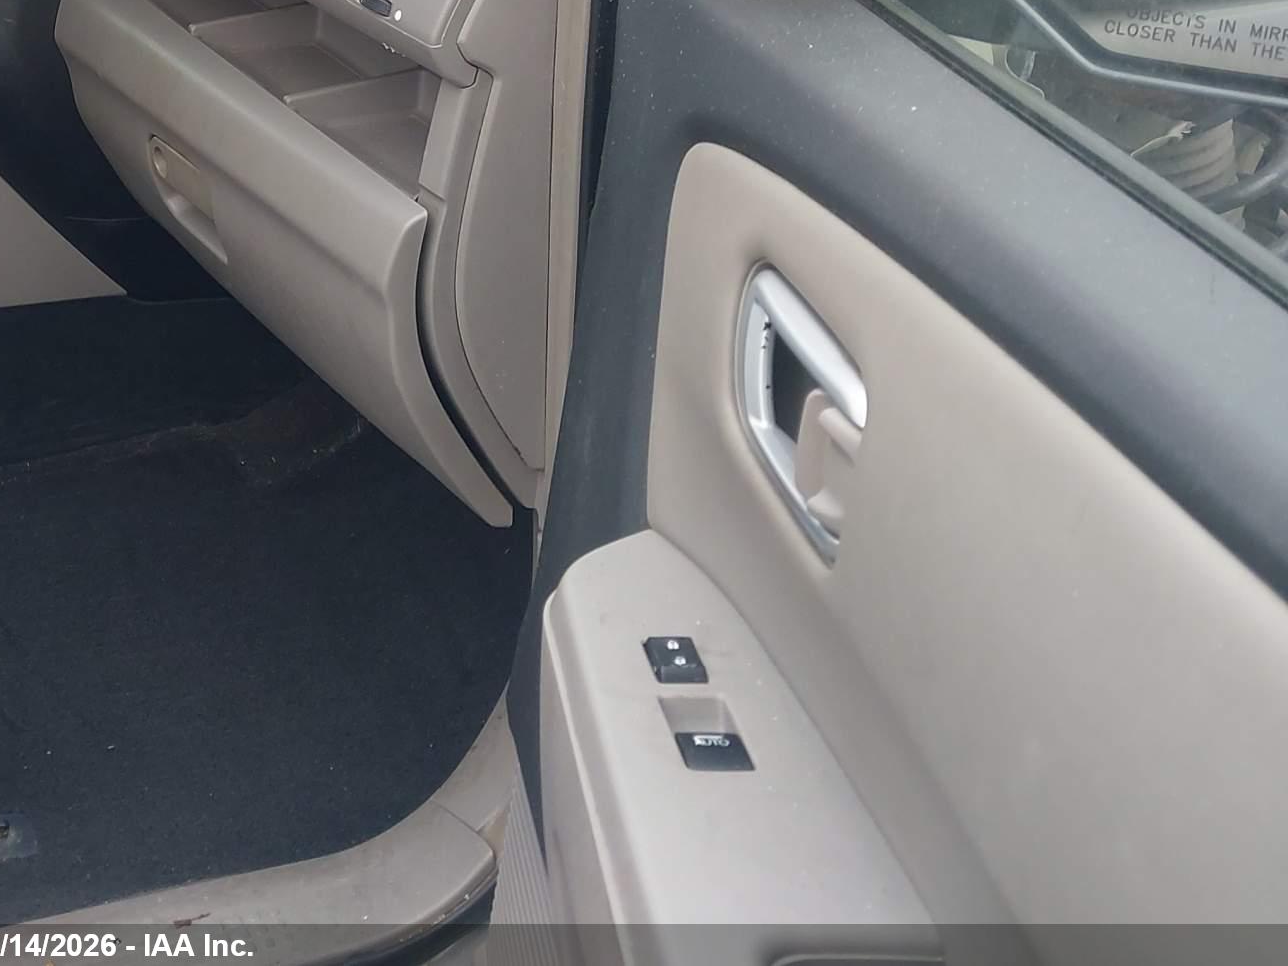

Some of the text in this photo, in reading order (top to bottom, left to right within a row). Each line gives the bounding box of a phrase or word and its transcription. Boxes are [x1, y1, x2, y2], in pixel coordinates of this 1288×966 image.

[1103, 18, 1176, 43] CLOSER
[1189, 32, 1237, 53] THAN
[1218, 19, 1238, 35] IN
